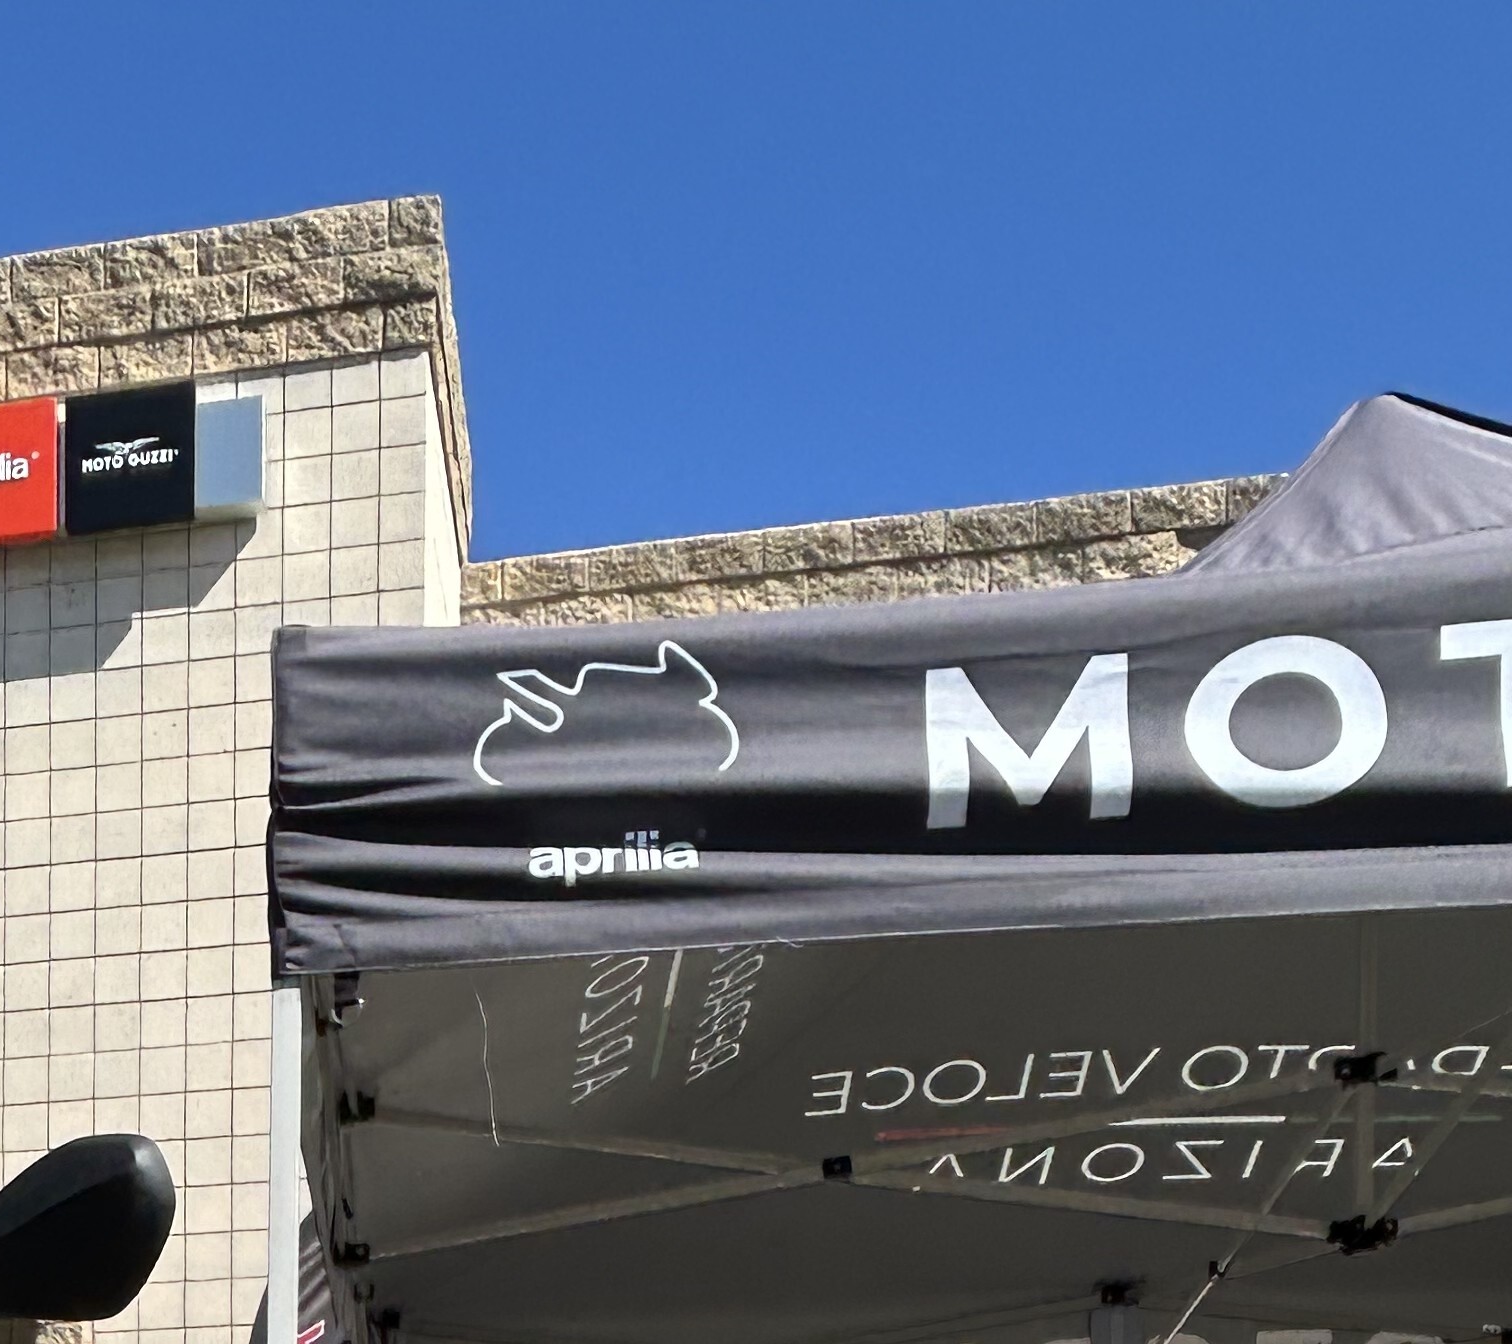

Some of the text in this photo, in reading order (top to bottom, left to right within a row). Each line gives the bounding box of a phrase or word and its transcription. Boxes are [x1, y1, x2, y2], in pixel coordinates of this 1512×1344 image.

[81, 448, 174, 473] MOTO GUZZI
[528, 829, 700, 888] aprilia
